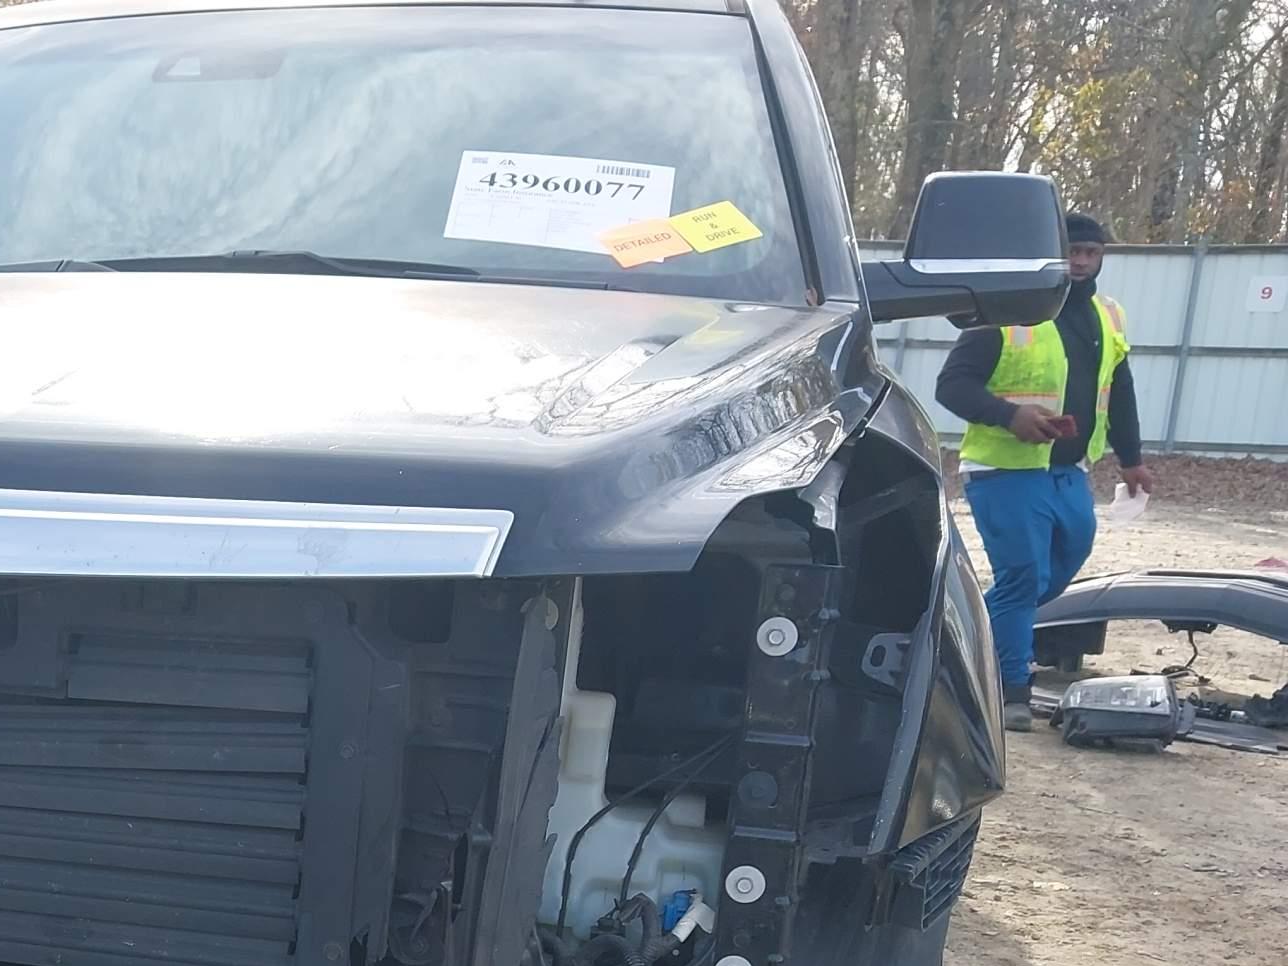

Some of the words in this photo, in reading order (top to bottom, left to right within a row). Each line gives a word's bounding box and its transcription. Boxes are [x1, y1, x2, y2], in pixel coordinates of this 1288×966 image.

[479, 171, 645, 201] 43960077
[691, 211, 717, 224] RUN
[613, 231, 672, 253] DETAILED
[705, 226, 740, 242] DRIVE
[1260, 286, 1273, 300] 9
